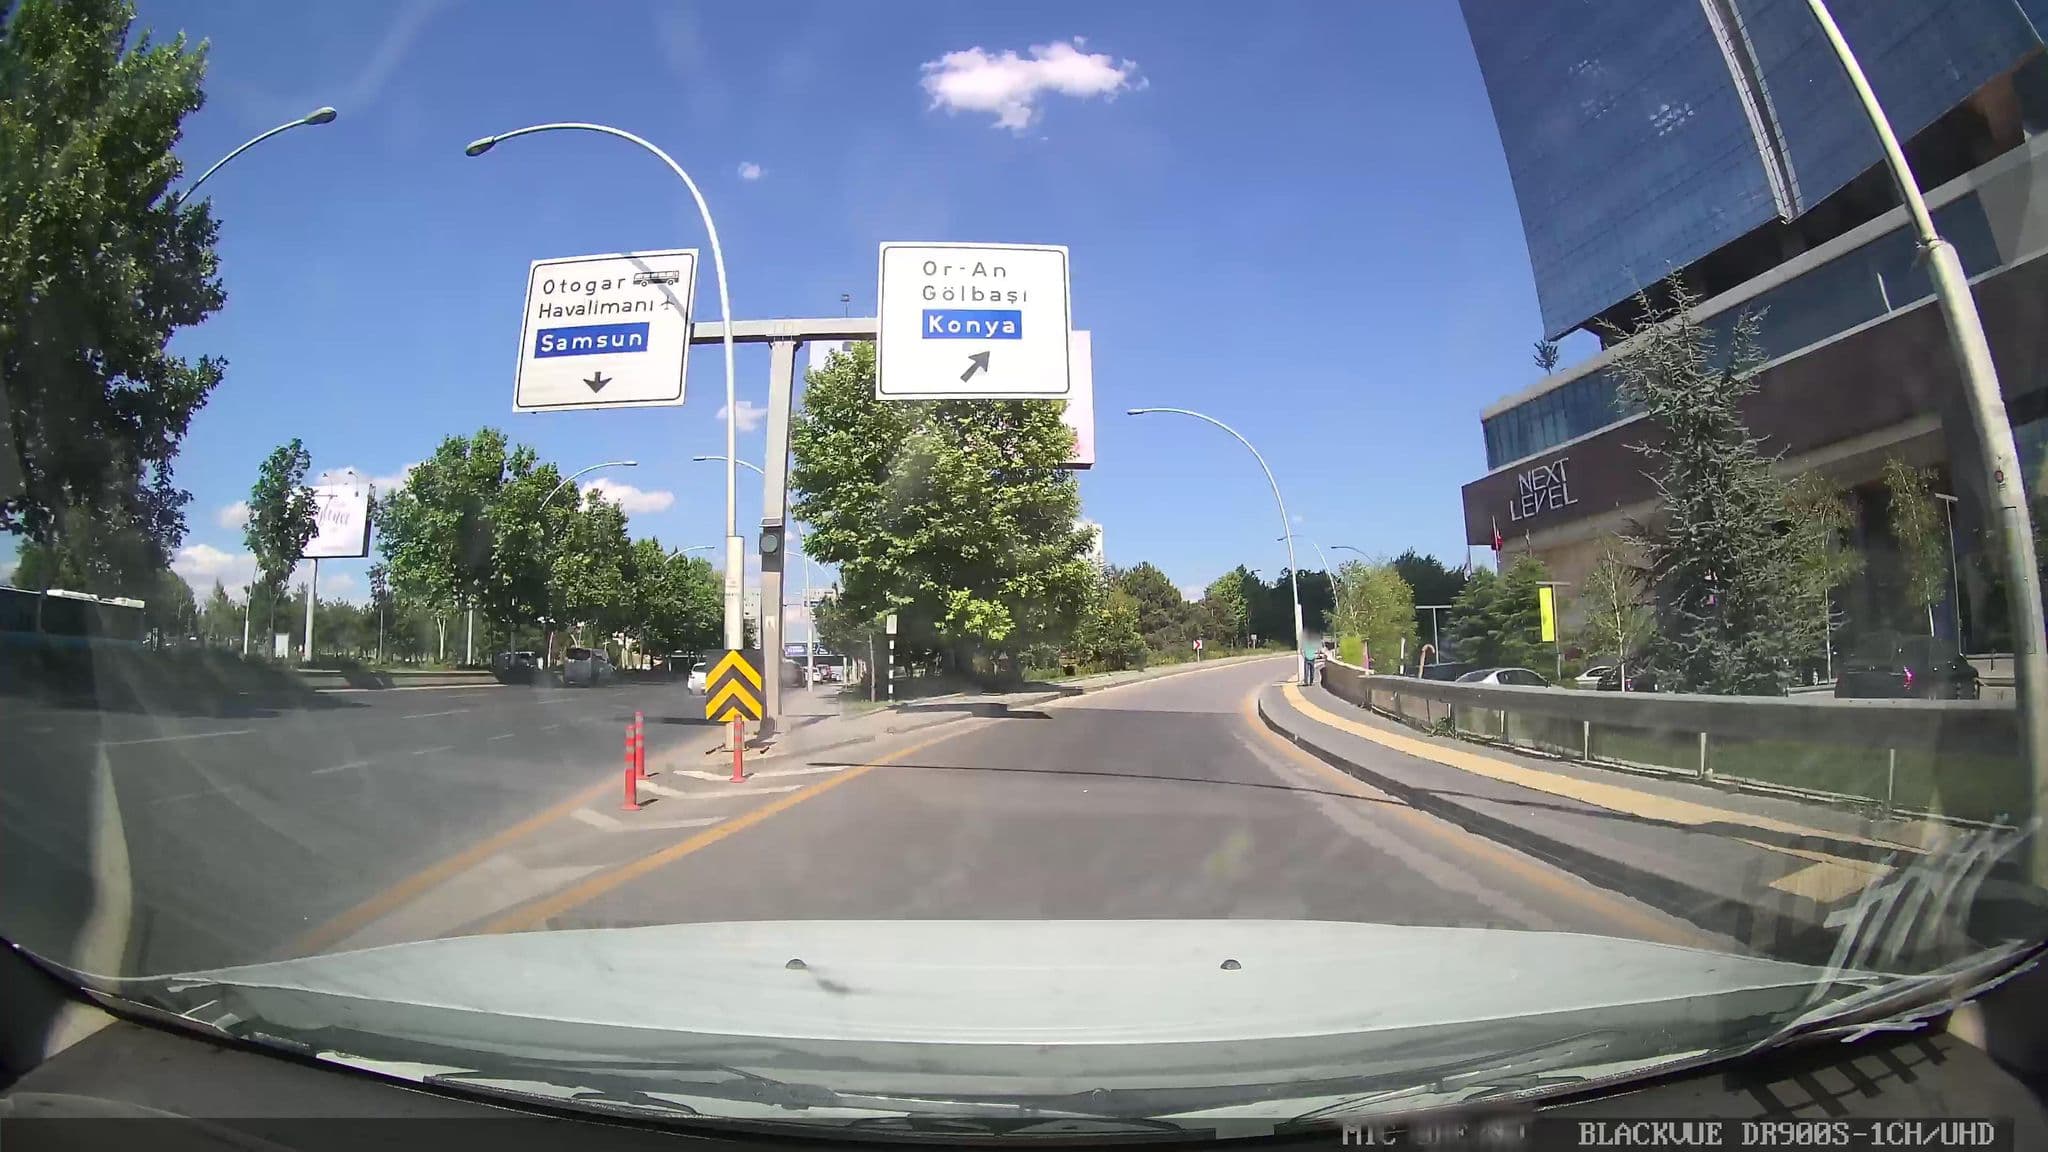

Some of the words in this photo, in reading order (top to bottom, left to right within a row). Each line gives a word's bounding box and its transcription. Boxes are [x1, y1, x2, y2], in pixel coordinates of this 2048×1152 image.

[922, 260, 1007, 278] Or-An
[543, 277, 626, 295] Otogar
[922, 285, 1027, 305] Gölbaşı
[538, 299, 654, 319] Havalimanı
[928, 314, 1016, 338] Konya
[540, 332, 643, 353] Samsun
[1518, 457, 1569, 495] NEXT
[1509, 483, 1579, 521] LEVEL
